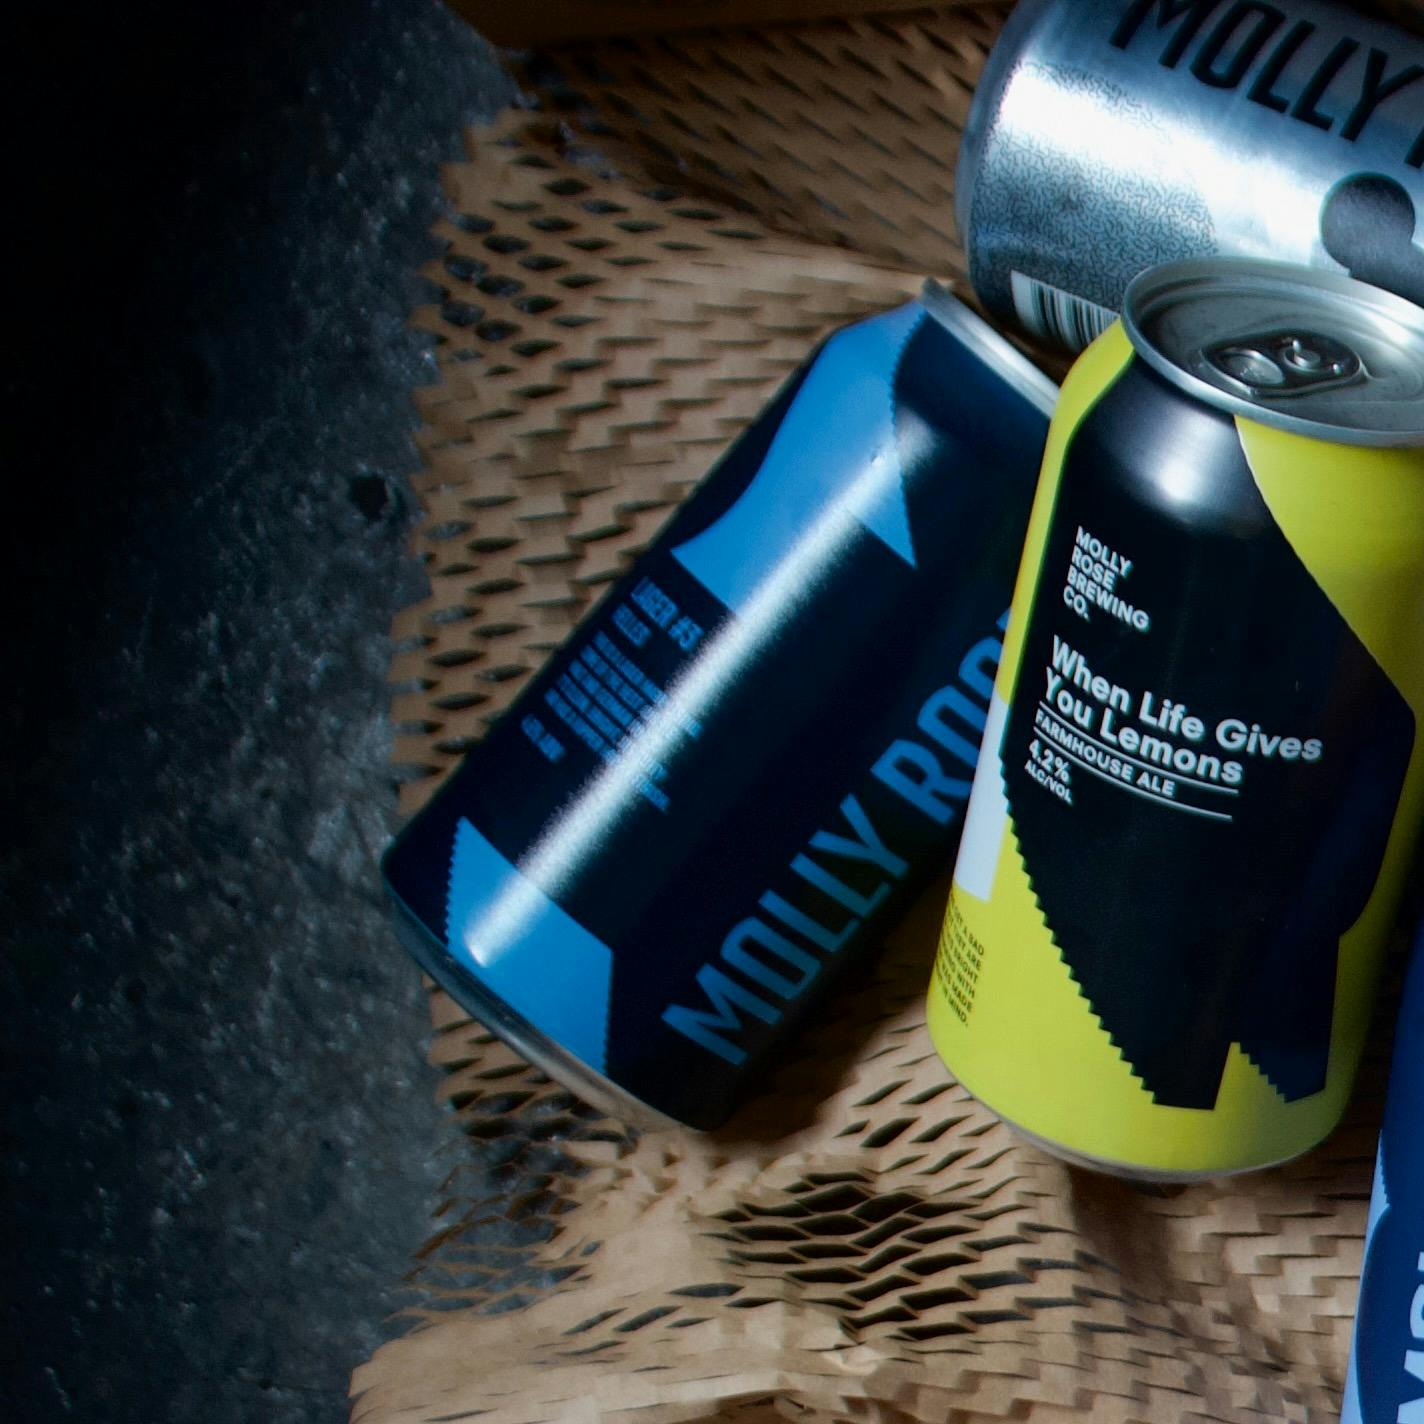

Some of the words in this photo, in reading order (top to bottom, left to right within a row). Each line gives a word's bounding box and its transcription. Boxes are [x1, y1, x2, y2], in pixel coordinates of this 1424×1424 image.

[1072, 546, 1116, 590] ROSE
[1076, 525, 1132, 578] MOLLY
[1063, 585, 1089, 621] CO.
[1067, 565, 1149, 631] BREWING
[1046, 666, 1093, 729] You
[1101, 707, 1243, 784] Lemons
[1053, 634, 1131, 712] When
[1139, 691, 1205, 741] Life
[1216, 718, 1323, 760] Gives
[1025, 760, 1073, 804] ALC/VOL
[1029, 739, 1071, 783] 4.2%
[1035, 708, 1133, 779] FARMHOUSE
[1137, 771, 1175, 797] ALE
[661, 793, 910, 1067] MOLLY
